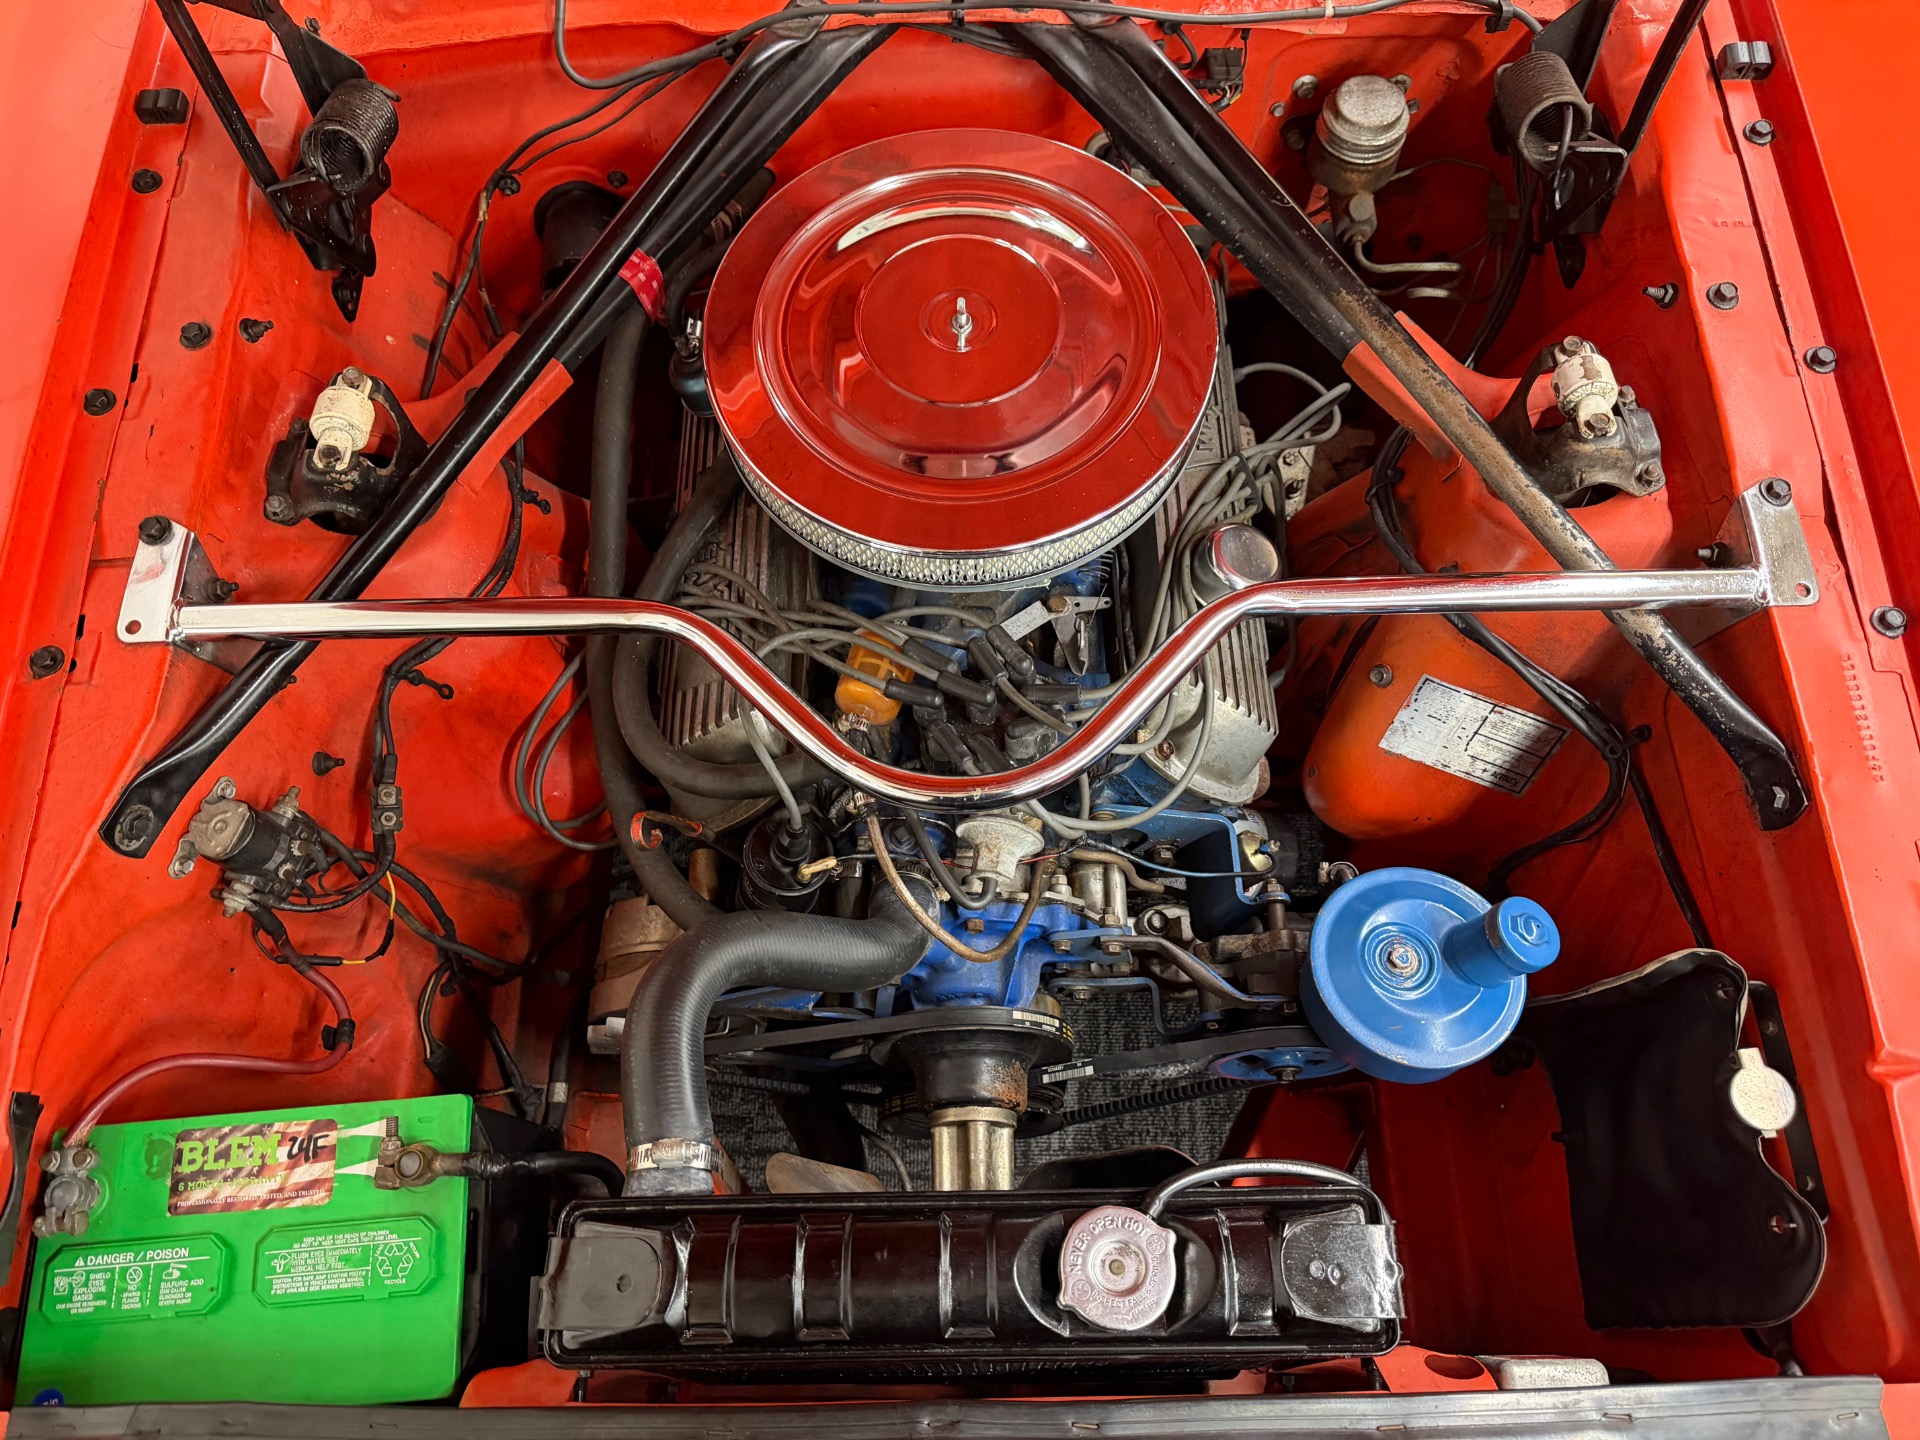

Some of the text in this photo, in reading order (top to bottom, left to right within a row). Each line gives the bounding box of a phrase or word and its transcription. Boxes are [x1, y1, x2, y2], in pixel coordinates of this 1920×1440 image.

[177, 1133, 282, 1173] BLEM
[178, 1182, 185, 1192] 6
[1069, 1216, 1150, 1275] NEVER OPEN HOT
[87, 1252, 134, 1266] DANGER
[146, 1247, 189, 1260] POISON
[291, 1252, 309, 1260] FLUSH
[311, 1250, 325, 1258] EYES
[89, 1272, 111, 1280] SHIELD
[88, 1279, 105, 1287] EYES
[160, 1278, 204, 1289] SULFURIC ACID
[1091, 1289, 1126, 1308] INSPECT
[1149, 1256, 1160, 1289] SPRING
